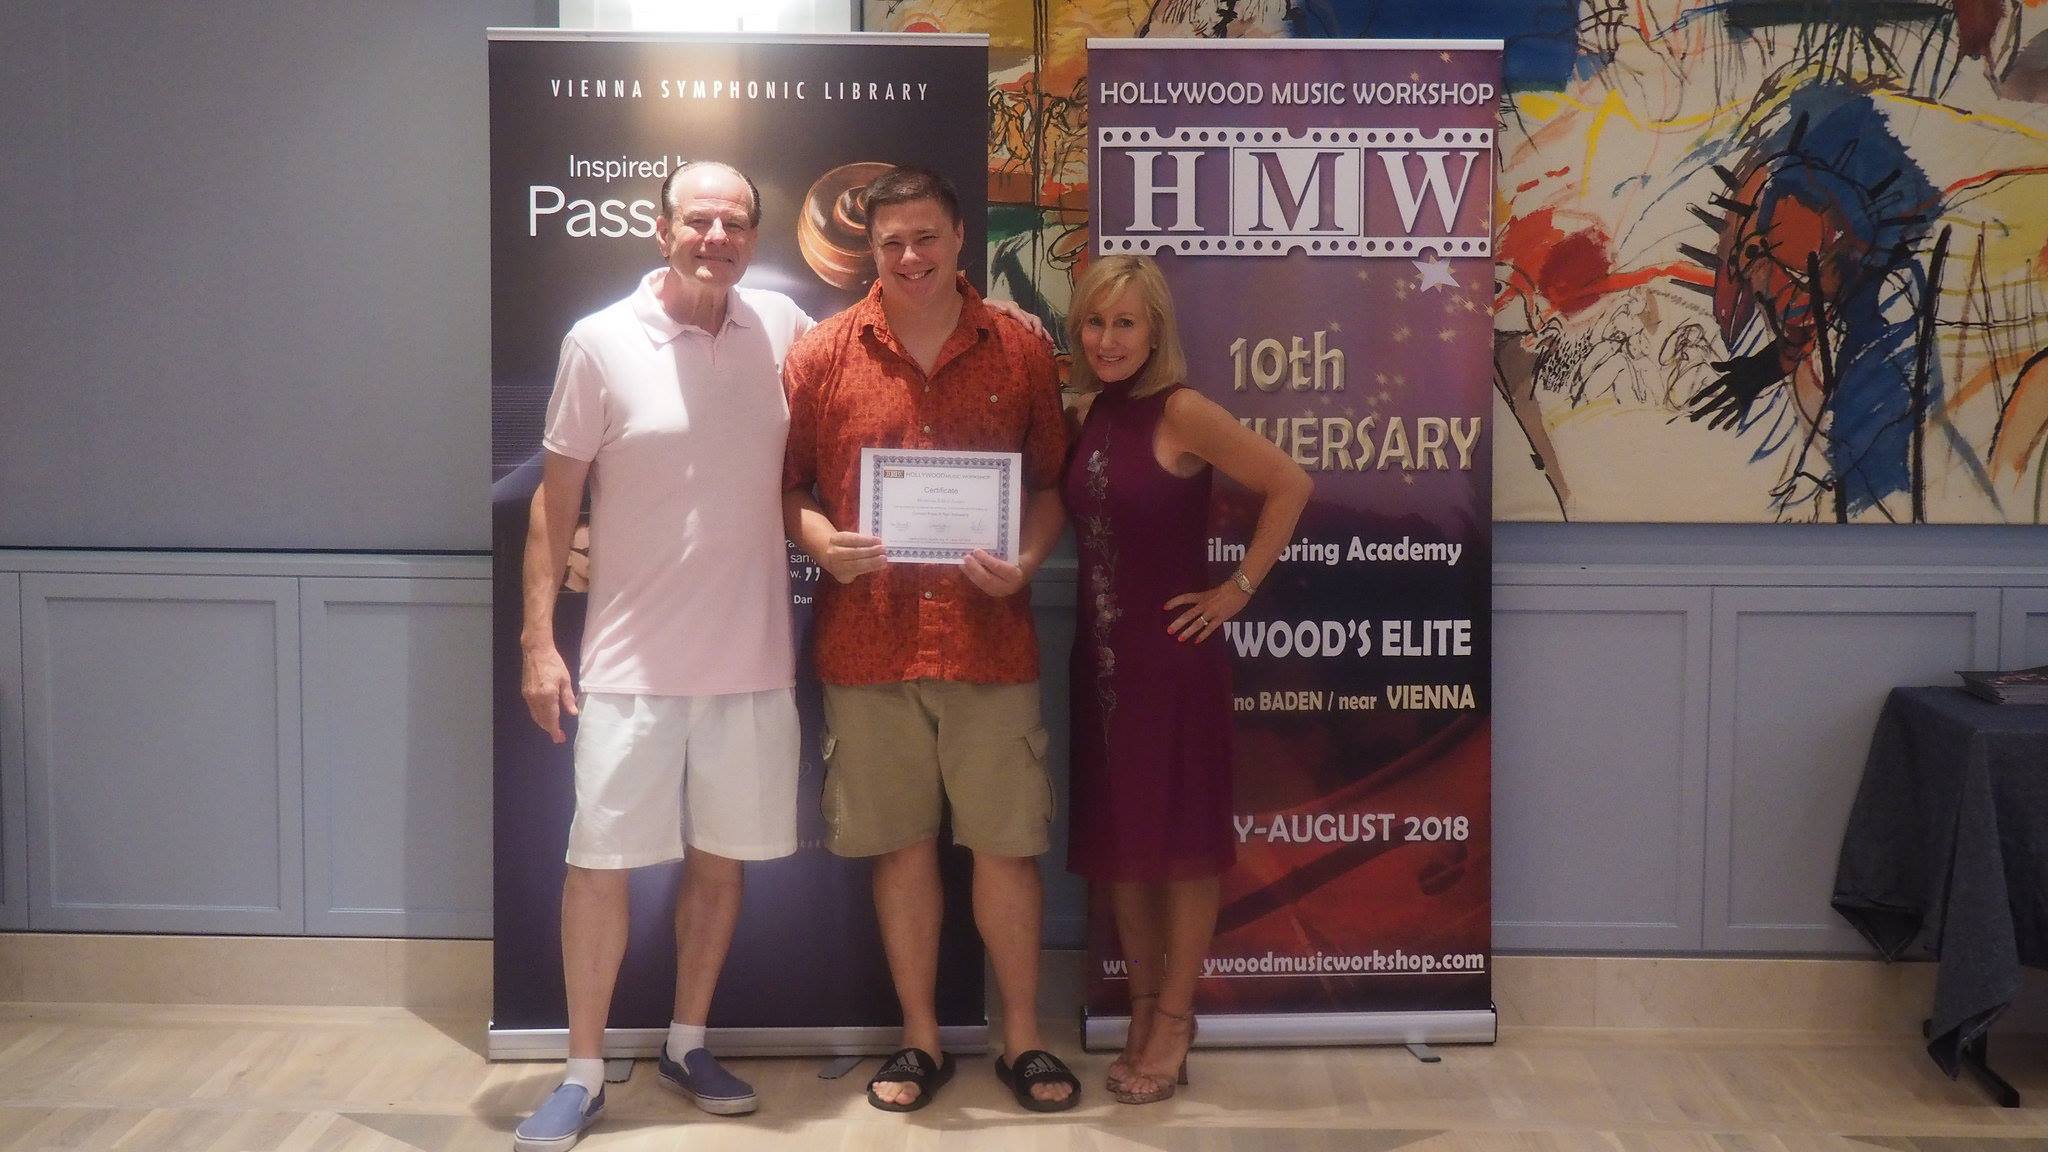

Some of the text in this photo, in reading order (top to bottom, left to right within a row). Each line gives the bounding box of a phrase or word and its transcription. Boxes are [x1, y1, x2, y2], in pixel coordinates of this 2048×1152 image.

[550, 79, 928, 101] VIENNA SYMPHONIC LIBRARY
[1100, 81, 1495, 105] HOLLYWOOD MUSIC WORKSHOP
[569, 154, 668, 183] Inspired
[529, 185, 657, 238] Pass
[1230, 330, 1346, 392] 10th
[1240, 416, 1482, 471] ERSARY
[1346, 536, 1463, 566] Academy
[1382, 619, 1472, 656] ELITE
[1259, 691, 1323, 712] BADEN
[1338, 692, 1378, 711] near
[1386, 684, 1476, 710] VIENNA
[1403, 815, 1470, 842] 2018
